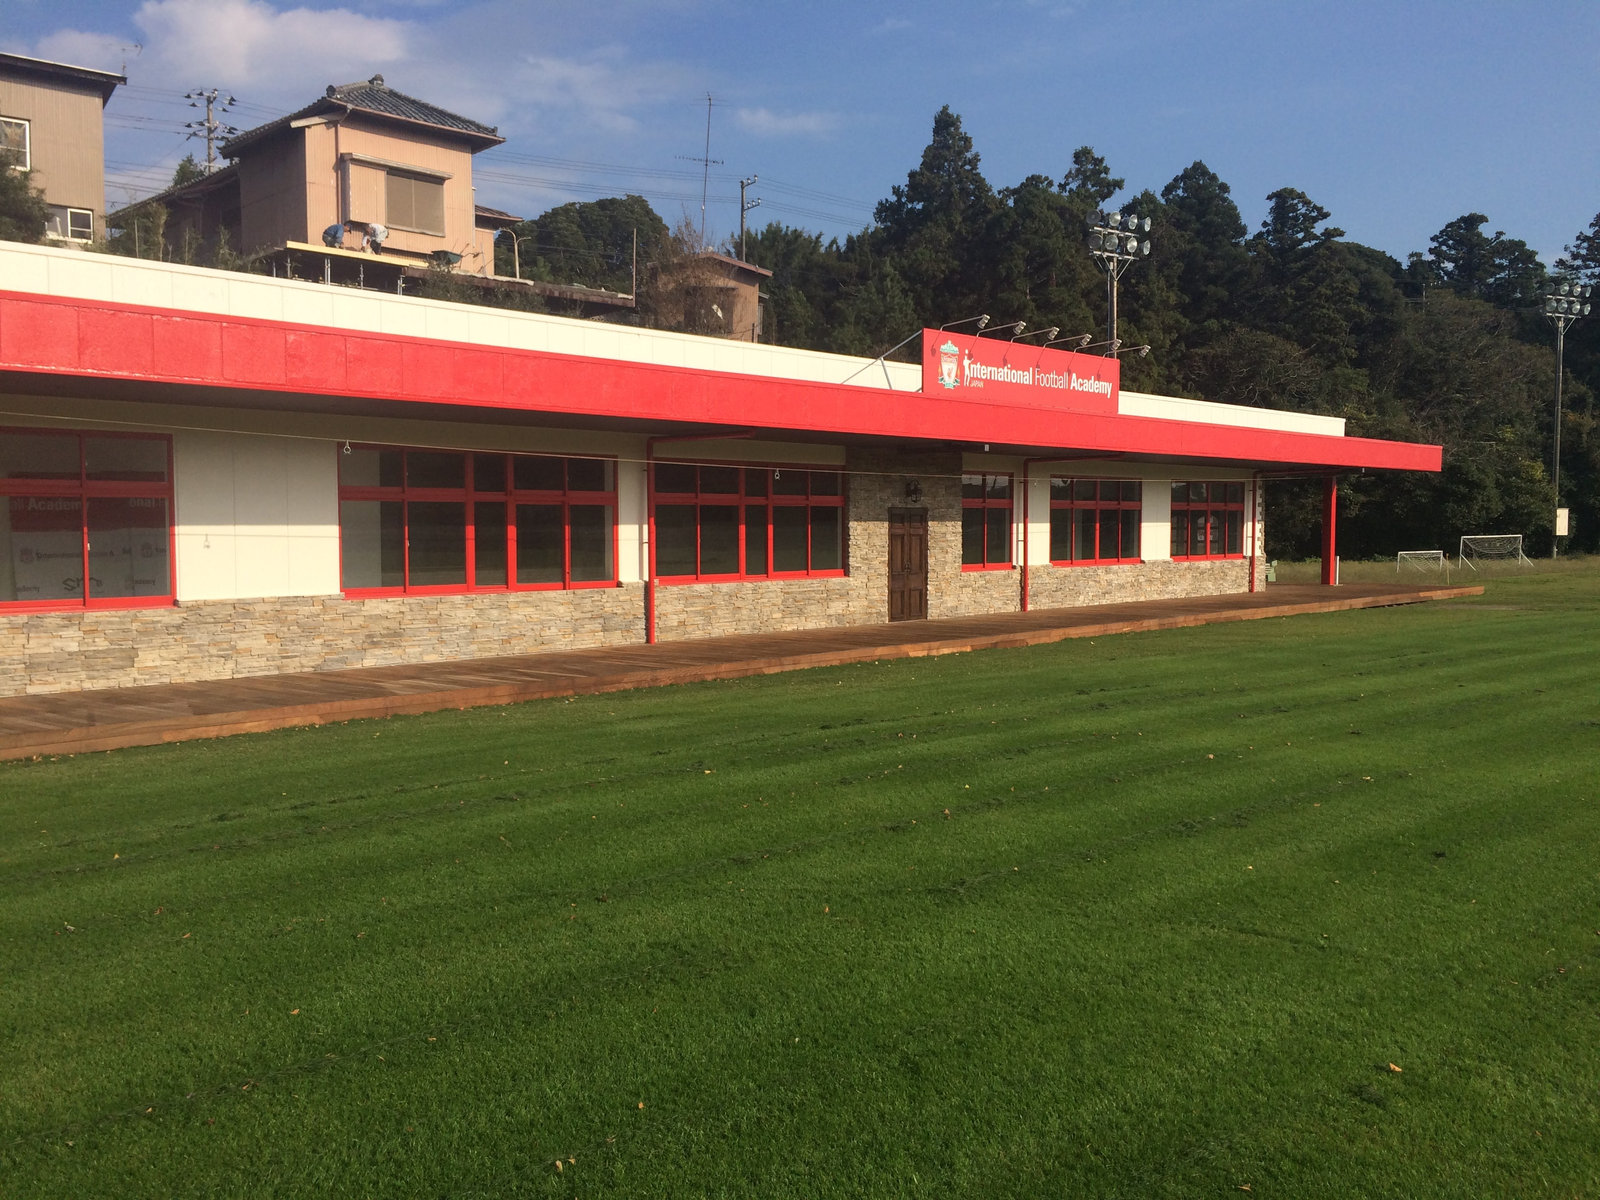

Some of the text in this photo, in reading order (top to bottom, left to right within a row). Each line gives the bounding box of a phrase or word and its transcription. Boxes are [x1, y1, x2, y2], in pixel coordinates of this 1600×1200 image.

[963, 349, 1113, 399] International Football Academy
[970, 380, 985, 389] JAPAN
